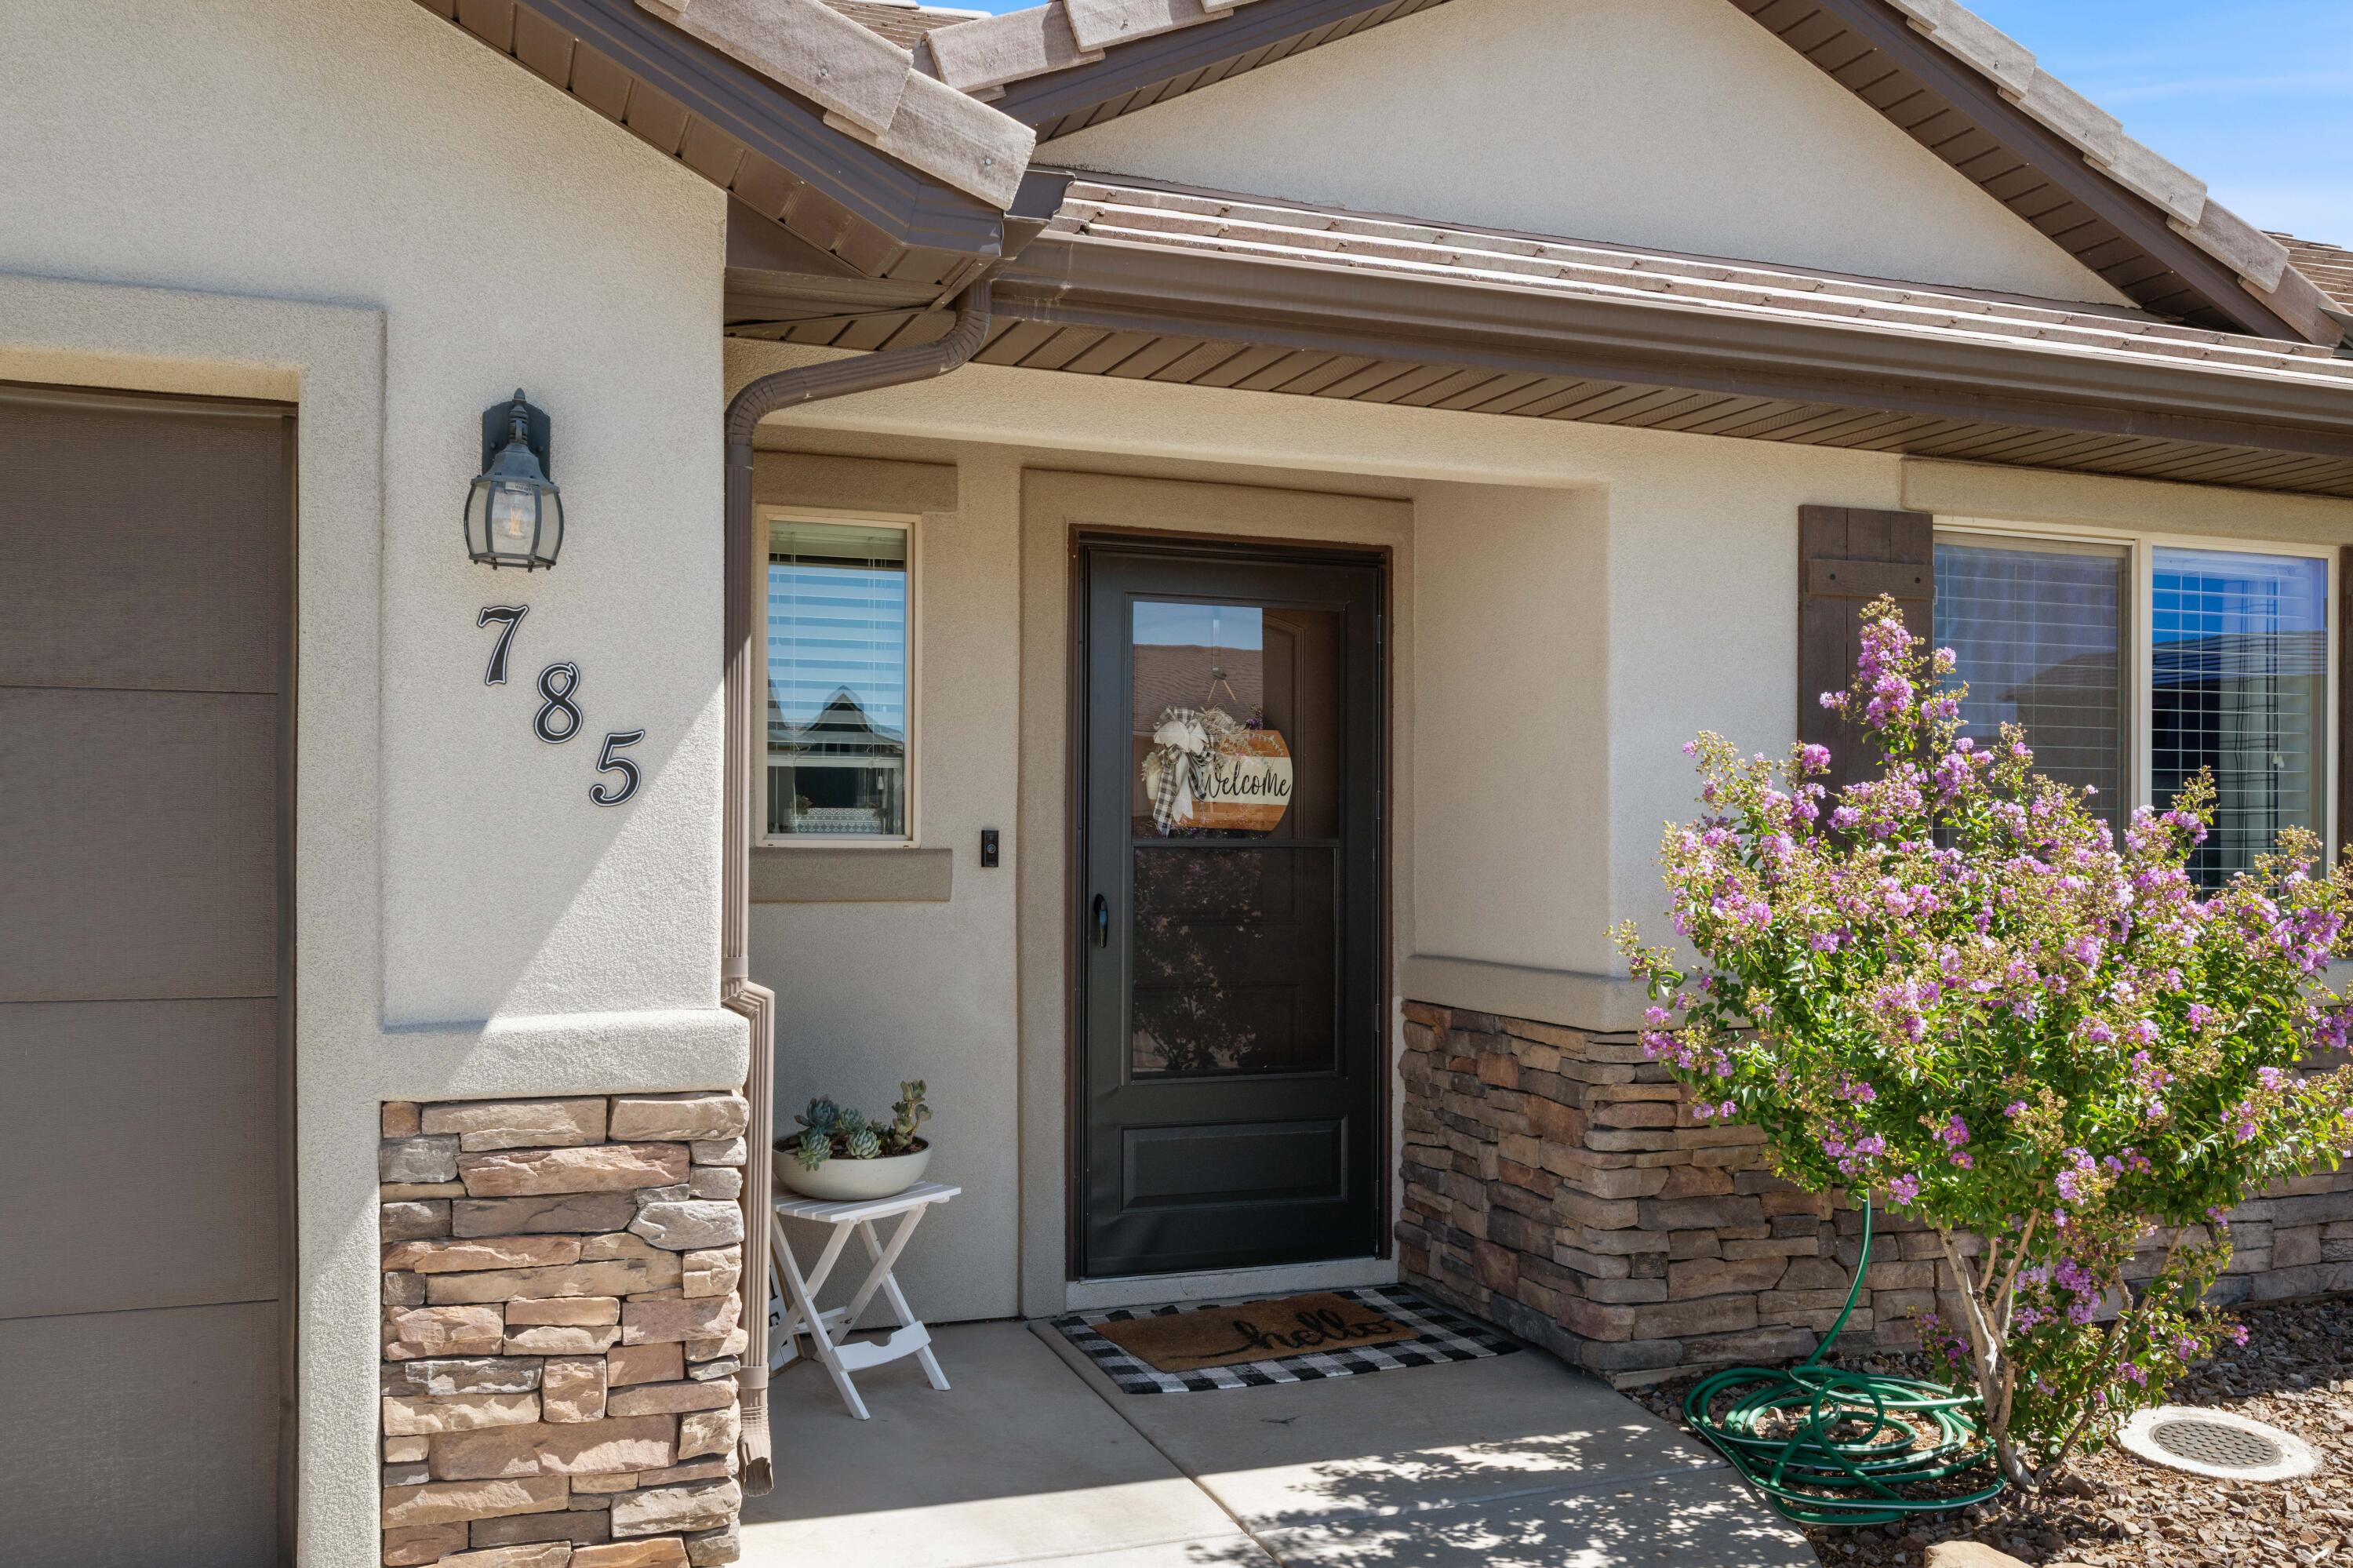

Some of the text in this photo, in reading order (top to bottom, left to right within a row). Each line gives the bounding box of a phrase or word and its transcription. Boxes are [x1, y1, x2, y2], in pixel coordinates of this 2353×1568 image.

[477, 604, 646, 807] 785
[1200, 760, 1292, 799] Welcome
[1165, 1309, 1392, 1359] hello
